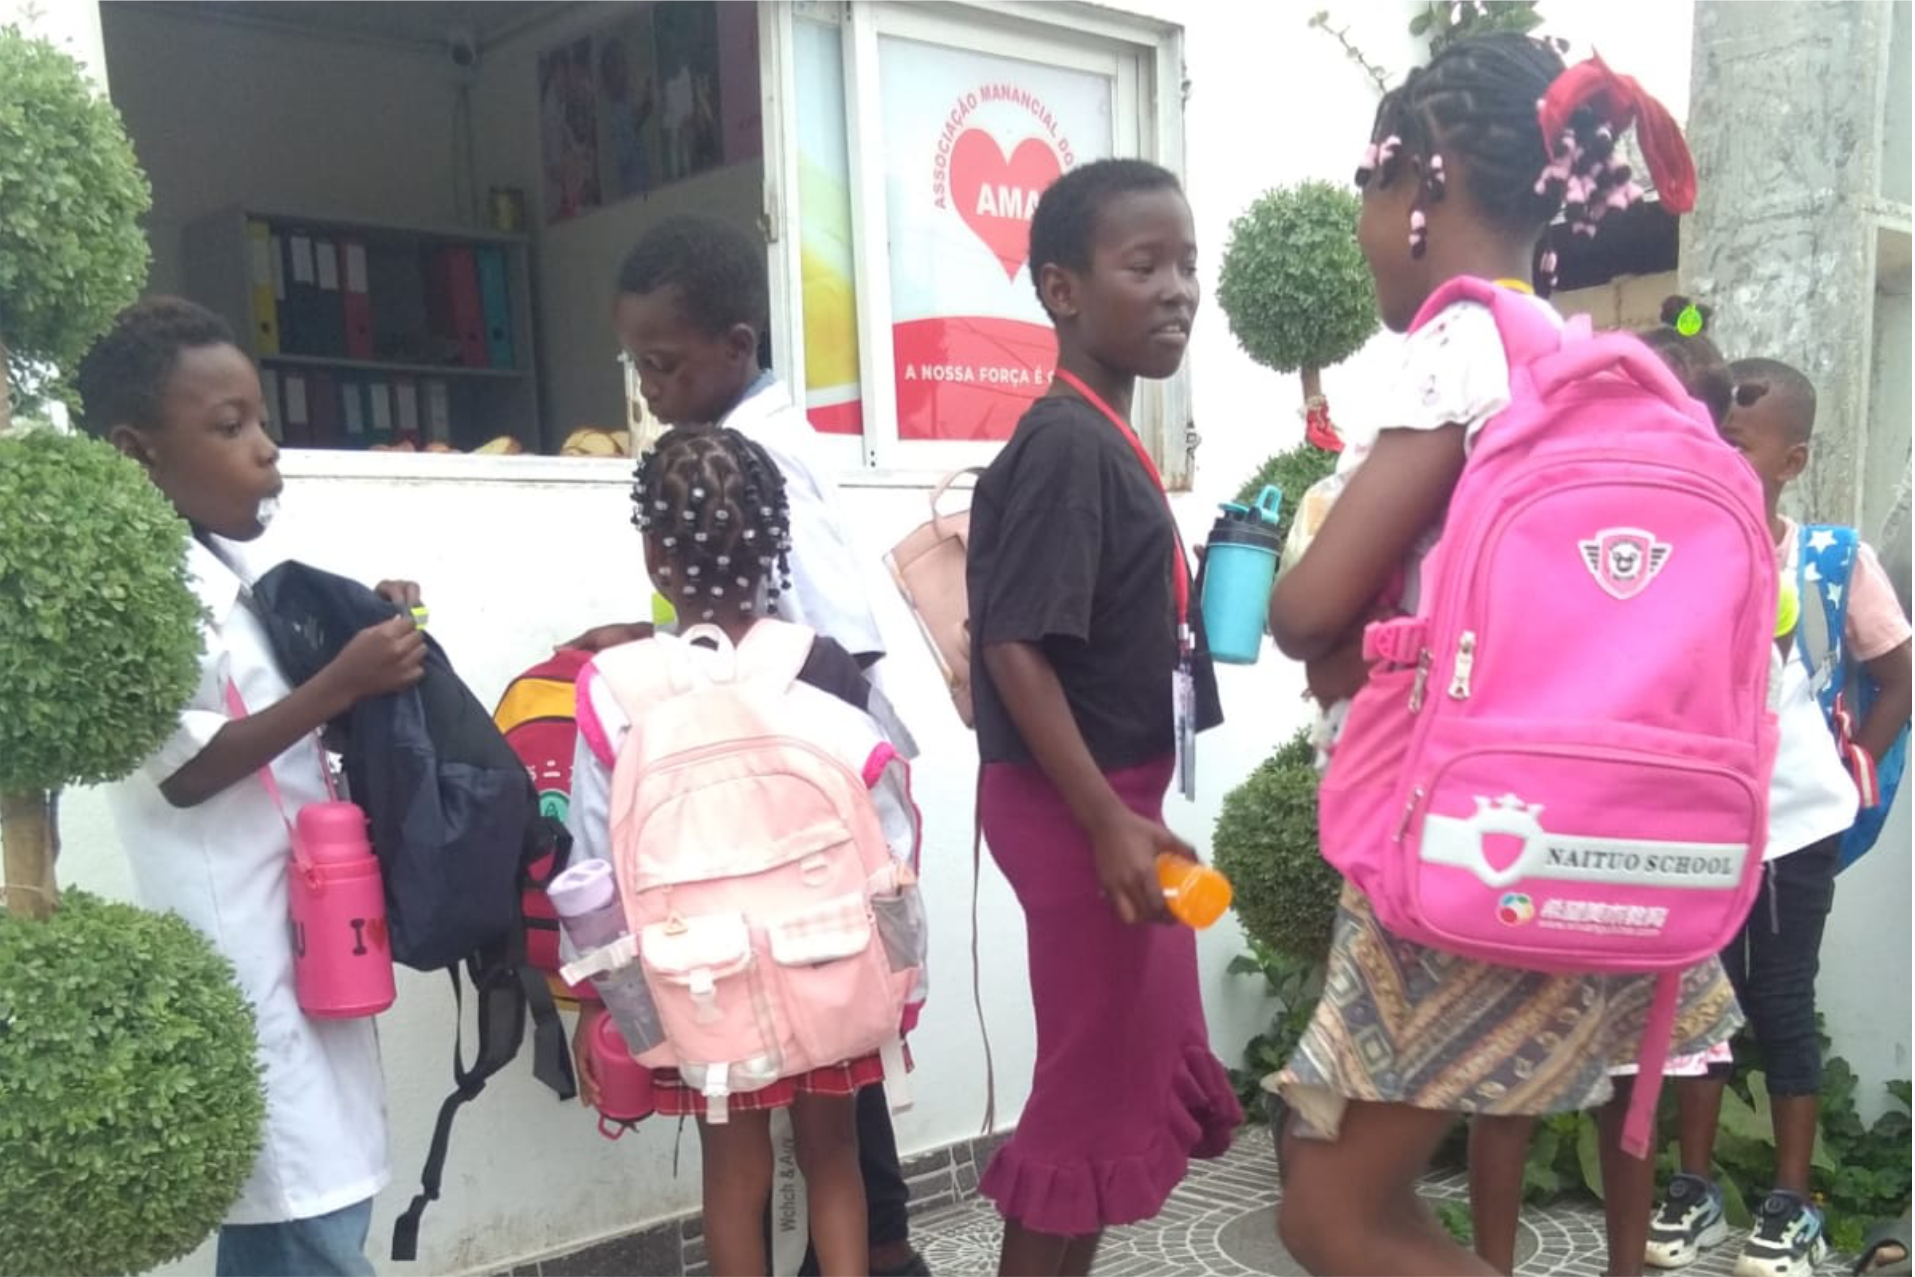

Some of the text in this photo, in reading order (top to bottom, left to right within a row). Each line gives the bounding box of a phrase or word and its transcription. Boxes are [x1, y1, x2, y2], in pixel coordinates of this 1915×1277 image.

[932, 83, 1075, 210] ASSOCIAÇÃO MANANCIAL DO
[904, 362, 917, 381] A
[921, 364, 975, 383] NOSSA
[979, 367, 1030, 388] FORÇA
[1034, 364, 1043, 385] É
[1545, 847, 1733, 876] NAITUO SCHOOL
